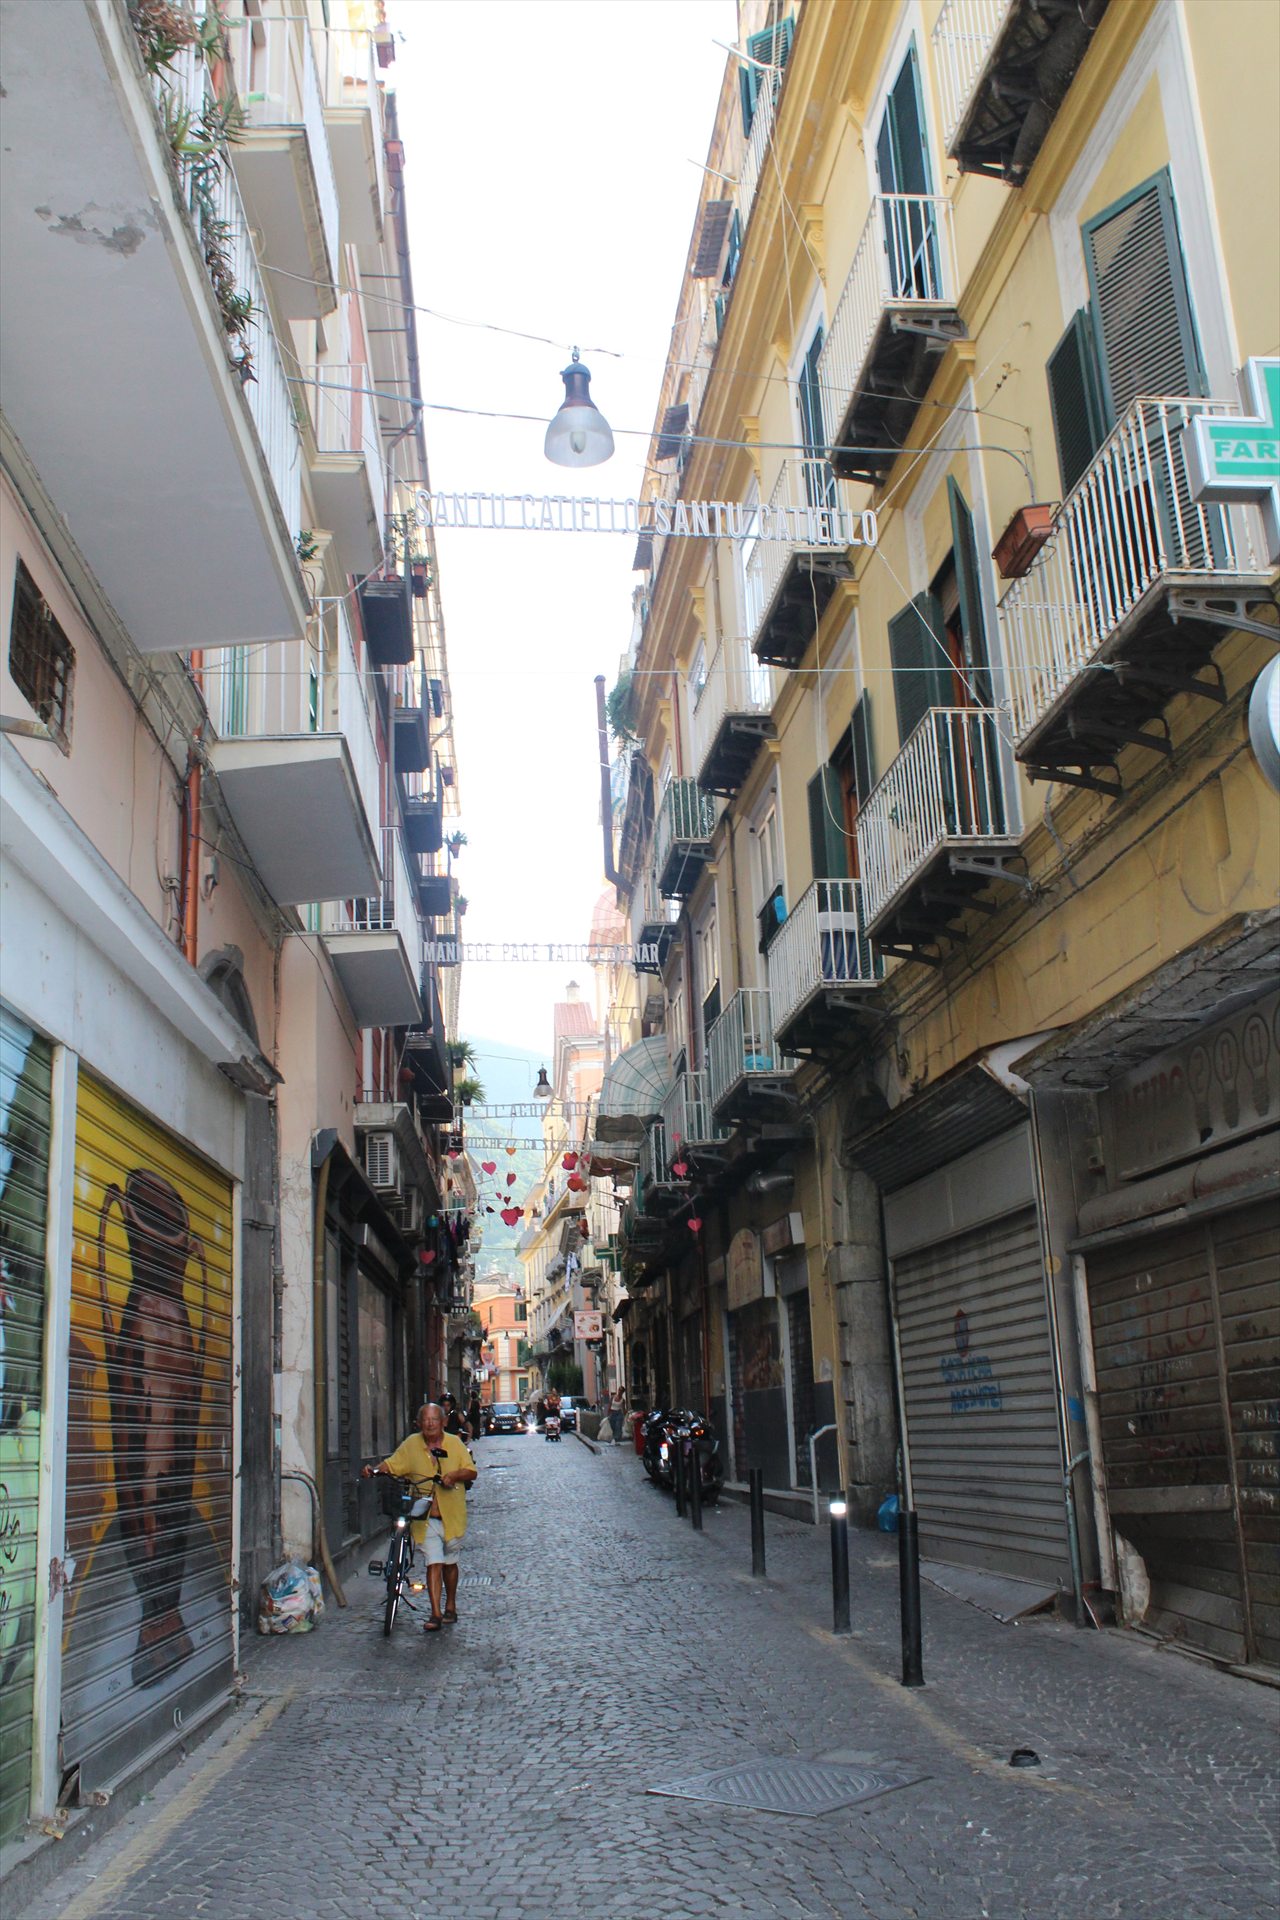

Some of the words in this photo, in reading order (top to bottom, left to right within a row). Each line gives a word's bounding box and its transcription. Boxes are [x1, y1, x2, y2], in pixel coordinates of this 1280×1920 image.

[1214, 440, 1279, 459] FAR
[414, 489, 507, 529] SANTU
[522, 493, 639, 533] CATIELLO
[654, 499, 744, 540] SANTU
[758, 503, 878, 547] CATIELLO
